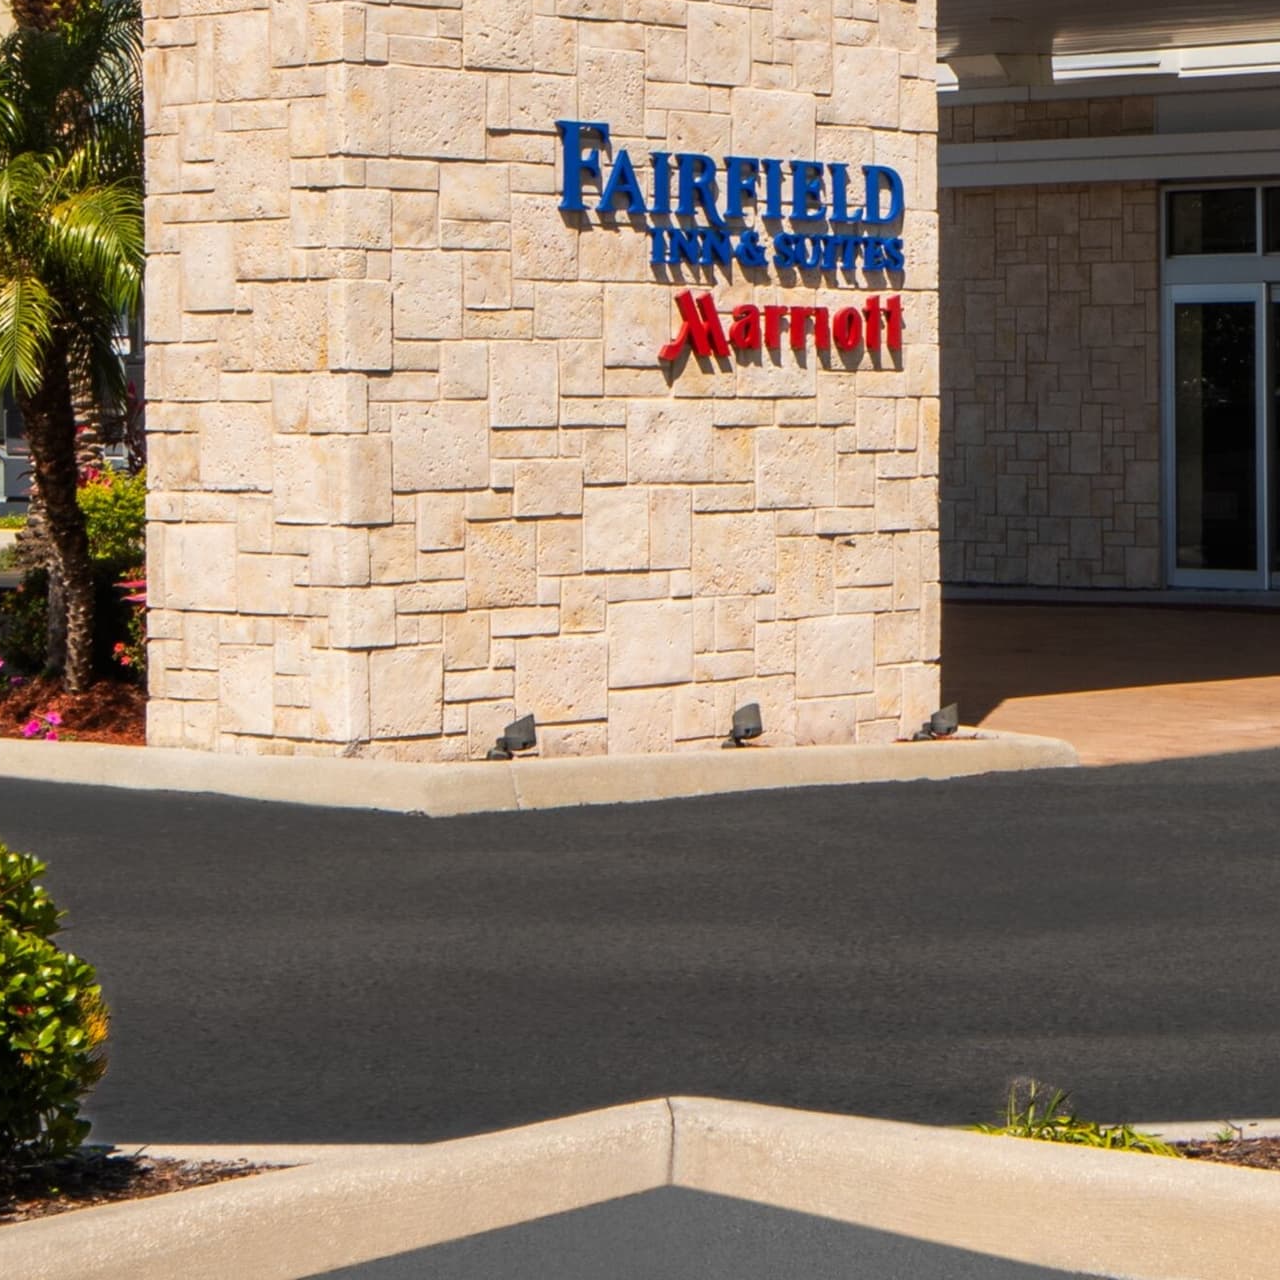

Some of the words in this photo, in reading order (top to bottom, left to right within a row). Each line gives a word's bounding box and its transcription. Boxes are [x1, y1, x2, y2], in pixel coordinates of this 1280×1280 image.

[555, 120, 905, 226] FAIRFIELD
[650, 226, 731, 266] INN
[735, 231, 768, 267] &
[773, 233, 904, 271] SUITES
[658, 289, 902, 361] Marriott
